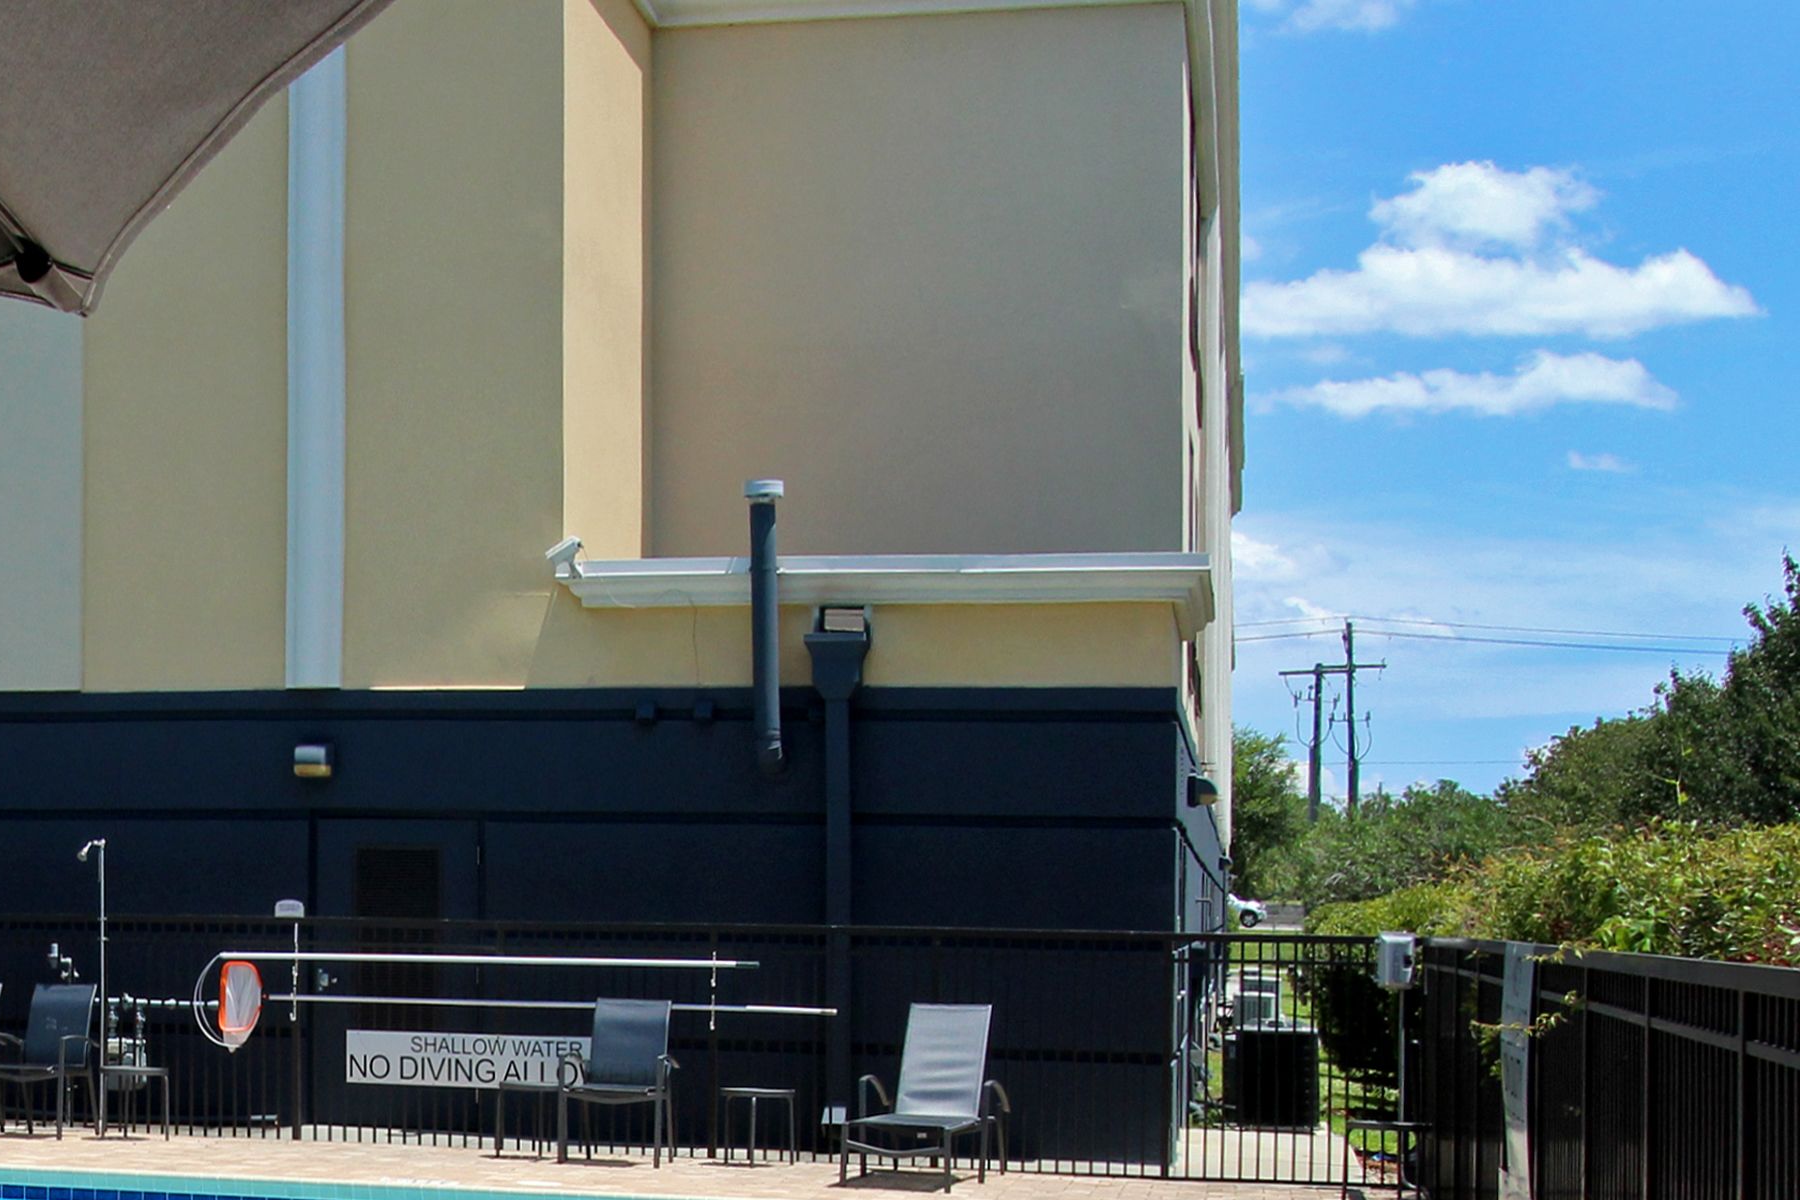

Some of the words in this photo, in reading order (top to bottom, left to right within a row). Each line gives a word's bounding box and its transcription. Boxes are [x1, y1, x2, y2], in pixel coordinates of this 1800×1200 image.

[410, 1035, 506, 1056] SHALLOW
[512, 1039, 583, 1058] WATER
[349, 1054, 390, 1079] NO
[400, 1056, 496, 1083] DIVING
